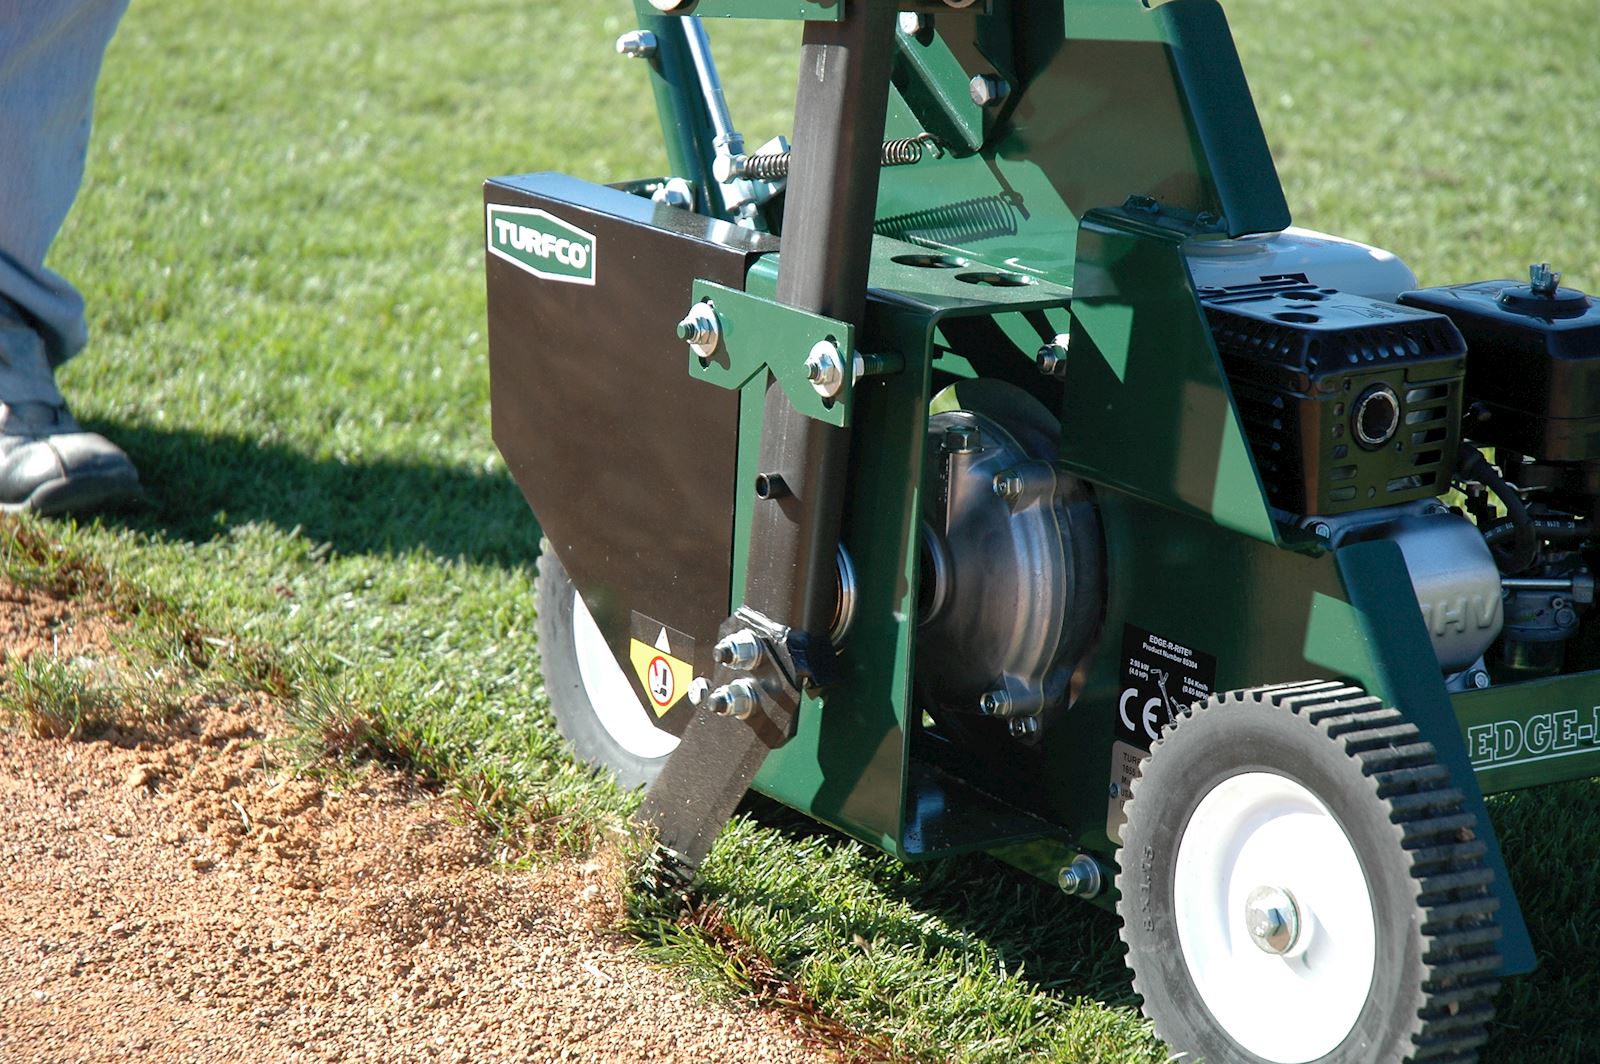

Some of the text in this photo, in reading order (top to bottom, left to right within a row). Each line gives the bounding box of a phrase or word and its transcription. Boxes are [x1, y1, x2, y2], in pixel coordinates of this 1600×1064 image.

[1142, 642, 1162, 655] Product
[1162, 650, 1182, 663] Number
[1195, 689, 1209, 700] MPH
[1468, 706, 1600, 765] EDGE-
